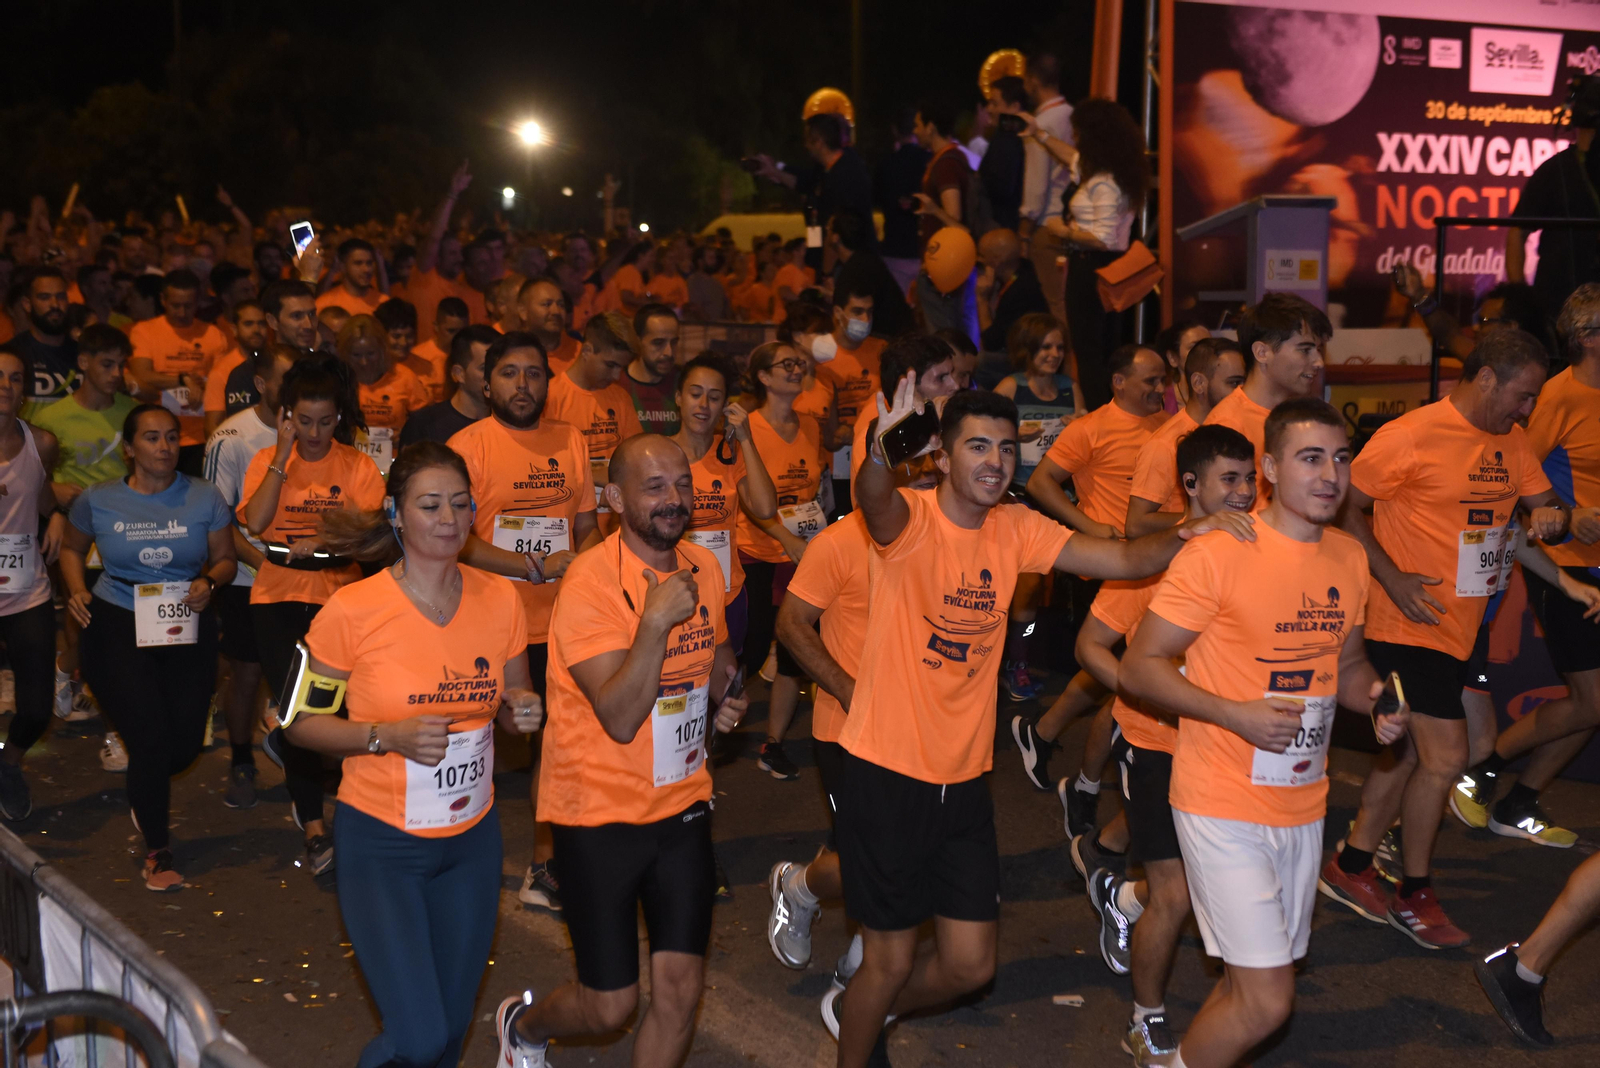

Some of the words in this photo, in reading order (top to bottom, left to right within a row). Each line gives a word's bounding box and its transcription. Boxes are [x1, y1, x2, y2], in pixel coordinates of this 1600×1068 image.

[1485, 41, 1541, 66] Sevilla
[1425, 100, 1446, 120] 30
[1446, 101, 1468, 121] de
[1468, 102, 1552, 127] septiembre
[1376, 131, 1485, 175] XXXIV
[1281, 258, 1294, 268] IMD
[228, 391, 252, 404] DXT
[528, 472, 566, 480] NOCTURNA
[1479, 466, 1509, 475] NOCTURNA
[1468, 474, 1494, 483] SEVILLA
[513, 481, 546, 490] SEVILLA
[303, 499, 345, 507] NOCTURNA
[285, 505, 321, 514] SEVILLA
[126, 521, 157, 530] ZURICH
[515, 538, 552, 555] 8145
[142, 551, 169, 560] D/SS
[157, 602, 192, 619] 6350
[1296, 610, 1345, 620] NOCTURNA
[1274, 622, 1319, 633] SEVILLA
[678, 626, 714, 643] NOCTURNA
[663, 641, 699, 660] SEVILLA
[437, 678, 498, 692] NOCTURNA
[662, 686, 688, 697] Sevilla
[407, 691, 466, 706] SEVILLA
[662, 700, 684, 710] Sevilla
[433, 756, 486, 790] 10733
